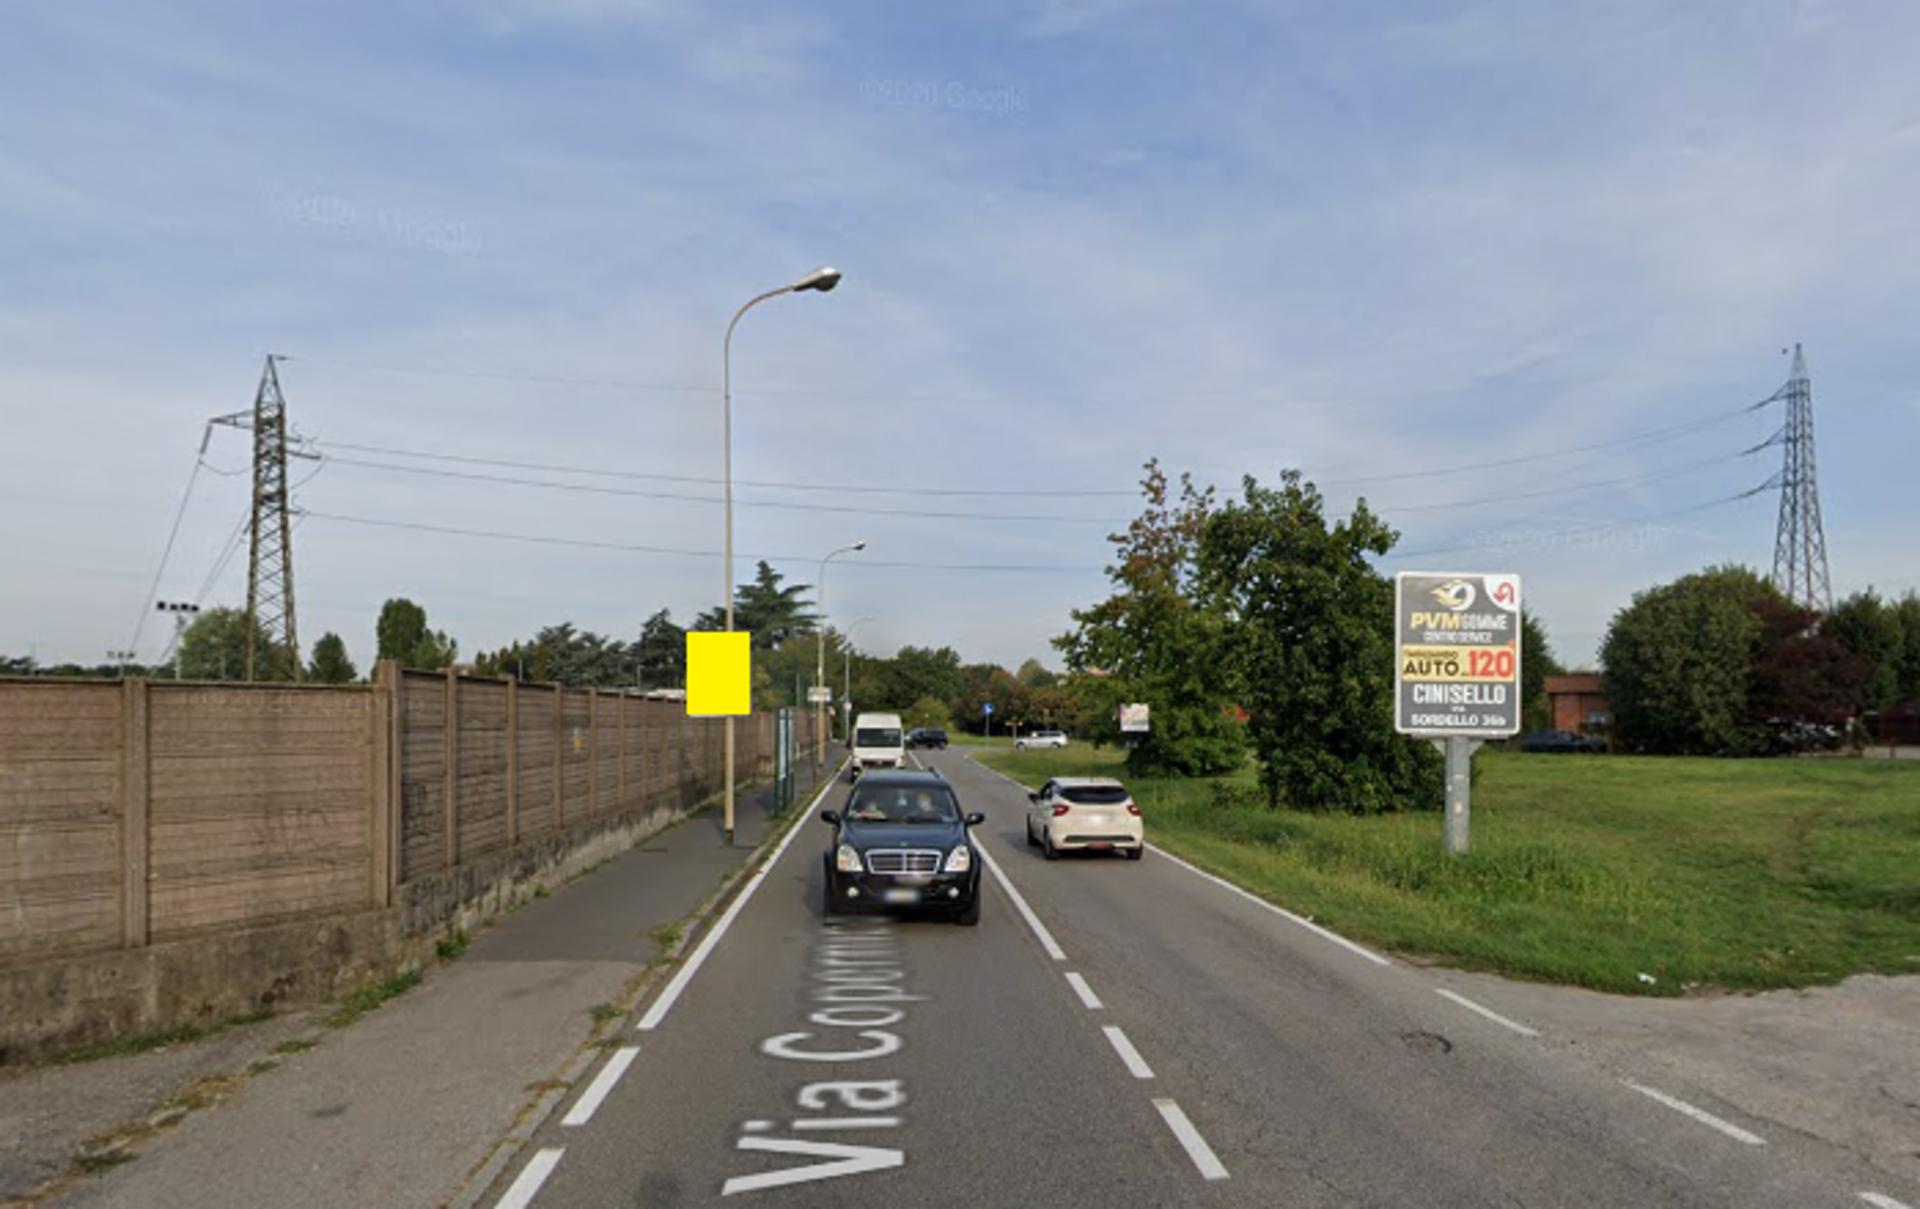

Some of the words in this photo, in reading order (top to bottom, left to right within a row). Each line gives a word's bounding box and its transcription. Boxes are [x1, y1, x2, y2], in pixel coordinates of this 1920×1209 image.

[1410, 612, 1461, 630] PVM
[1404, 660, 1460, 676] AUTO
[1468, 650, 1515, 678] 120
[1413, 683, 1507, 704] CINISELLO
